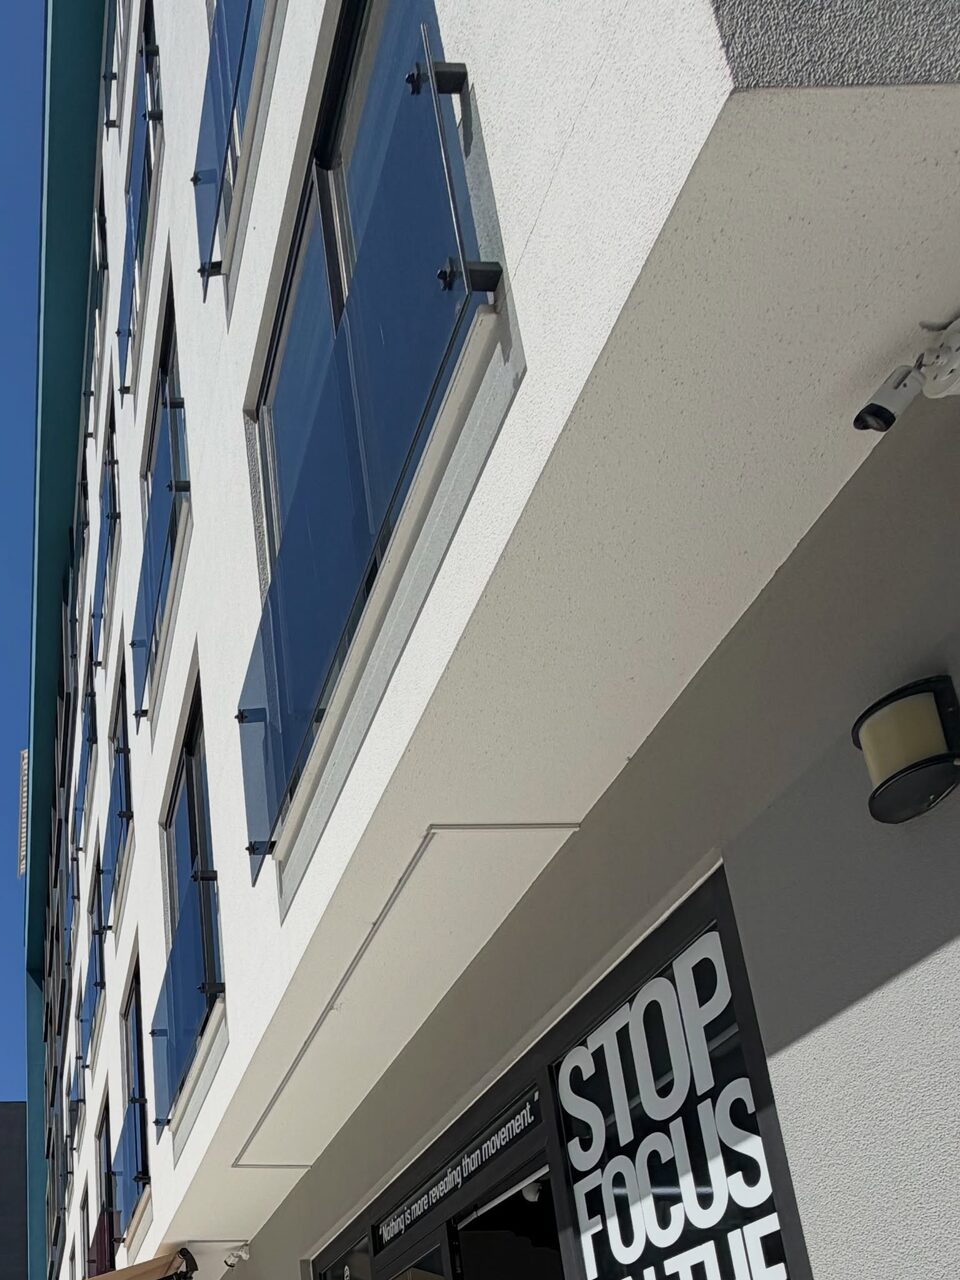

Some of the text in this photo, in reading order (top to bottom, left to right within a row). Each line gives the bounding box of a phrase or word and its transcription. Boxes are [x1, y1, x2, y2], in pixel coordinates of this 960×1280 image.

[557, 930, 732, 1172] STOP
[405, 1206, 412, 1226] is
[411, 1194, 429, 1221] more
[428, 1165, 462, 1206] revealing
[462, 1154, 481, 1178] than
